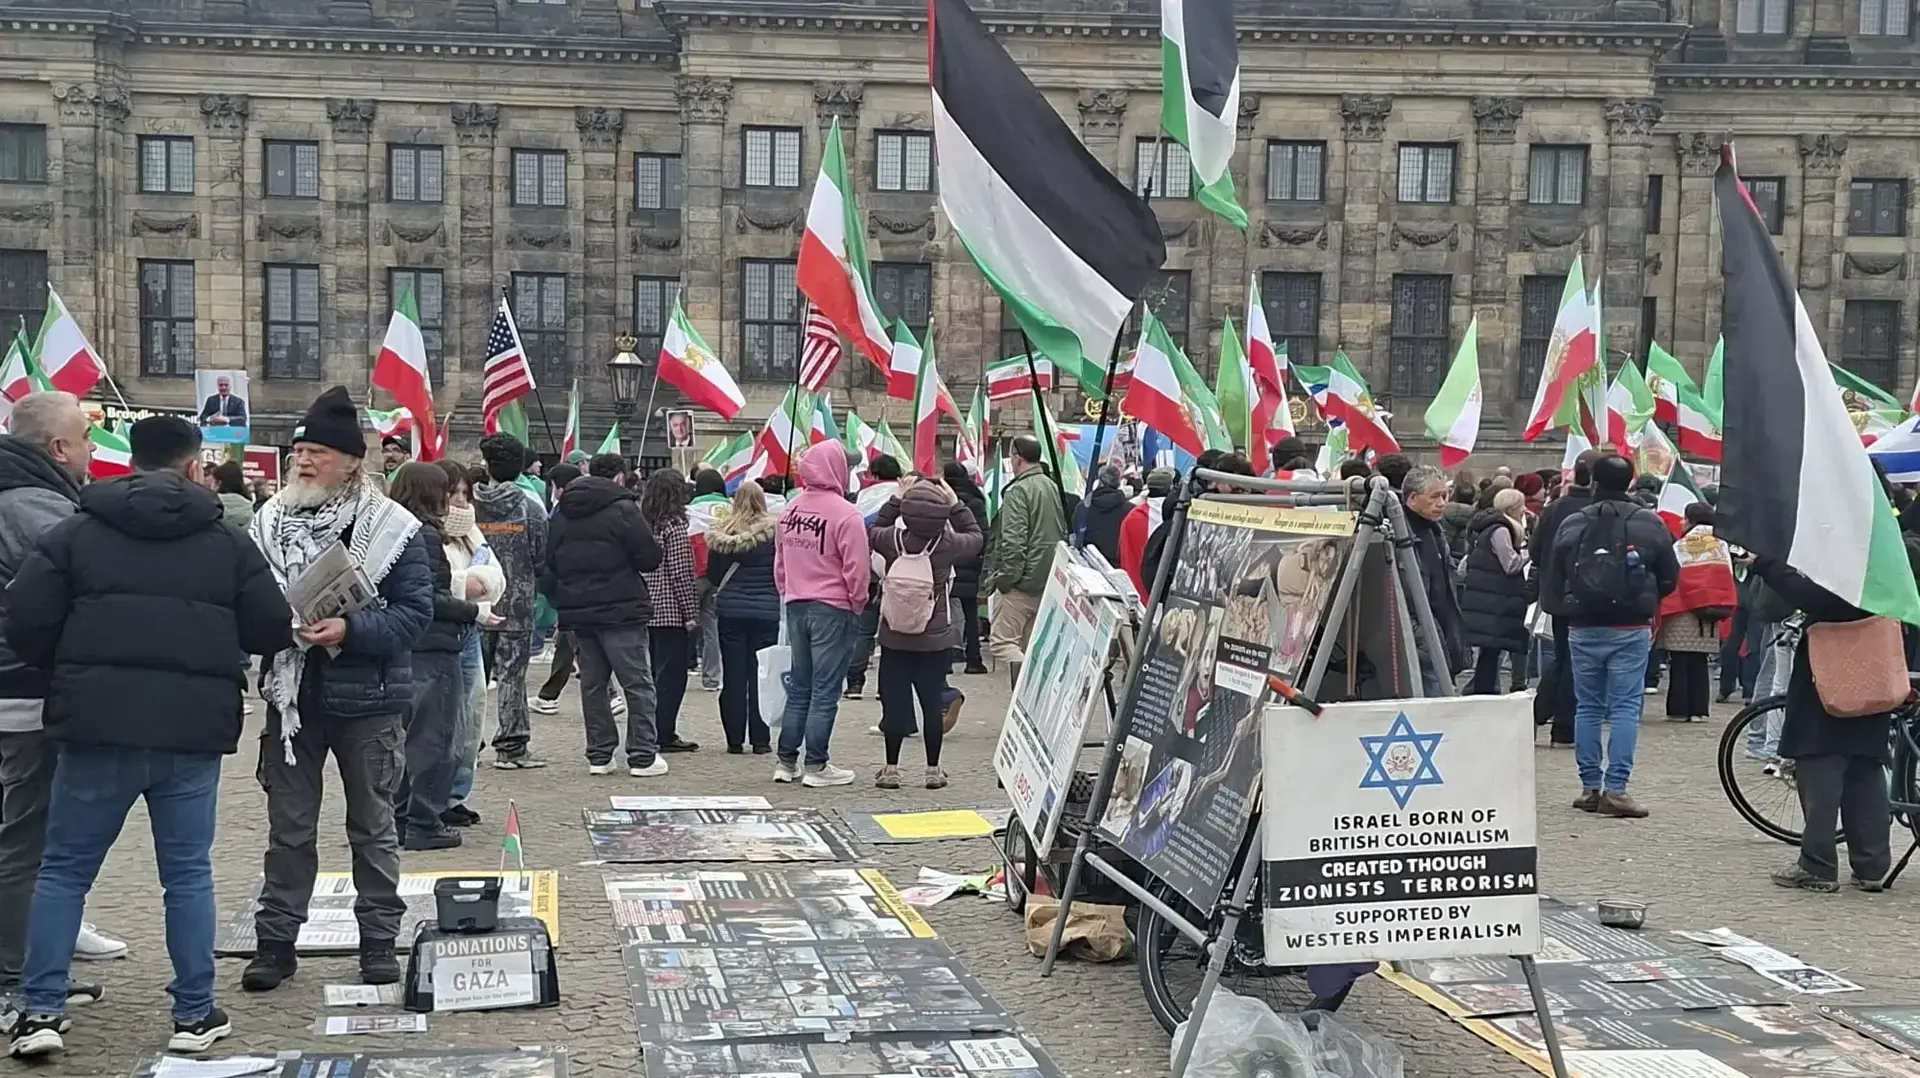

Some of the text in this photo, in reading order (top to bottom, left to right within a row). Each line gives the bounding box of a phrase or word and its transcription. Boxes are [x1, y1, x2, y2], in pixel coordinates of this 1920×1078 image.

[1334, 809, 1497, 830] ISRAEL BORN OF
[1309, 829, 1509, 852] BRITISH COLONIALISM
[1321, 855, 1487, 878] CREATED THOUGH
[1280, 873, 1534, 901] ZIONISTS TERRORISM
[1335, 905, 1471, 925] SUPPORTED BY
[436, 935, 528, 956] DONATIONS
[1286, 923, 1522, 949] WESTERS IMPERIALISM
[471, 958, 492, 968] FOR
[453, 969, 509, 991] GAZA
